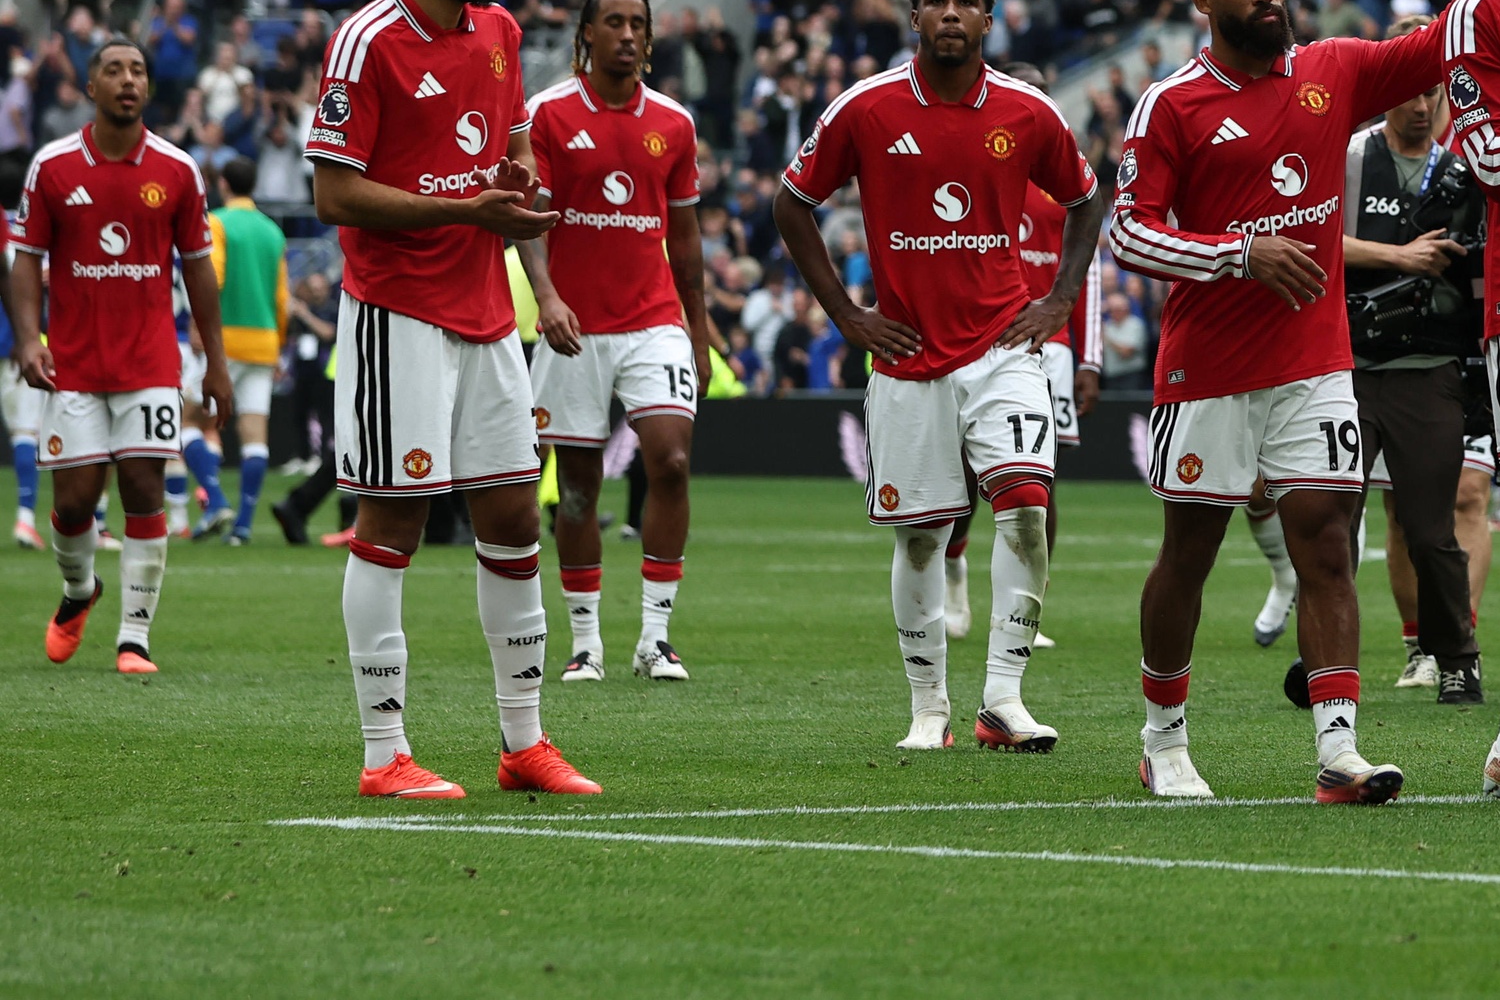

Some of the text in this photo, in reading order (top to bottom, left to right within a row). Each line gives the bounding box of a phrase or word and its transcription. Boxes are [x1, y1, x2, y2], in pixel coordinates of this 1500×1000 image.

[564, 207, 661, 232] Snapdragon
[1226, 195, 1339, 236] Snapdragon
[1365, 196, 1400, 216] 266
[889, 230, 1010, 255] Snapdragon
[72, 260, 161, 281] Snapdragon
[663, 364, 694, 402] 15
[140, 404, 177, 441] 18
[1053, 395, 1072, 429] 3
[1007, 413, 1049, 454] 17
[1319, 420, 1359, 471] 19
[360, 665, 401, 678] MUFC
